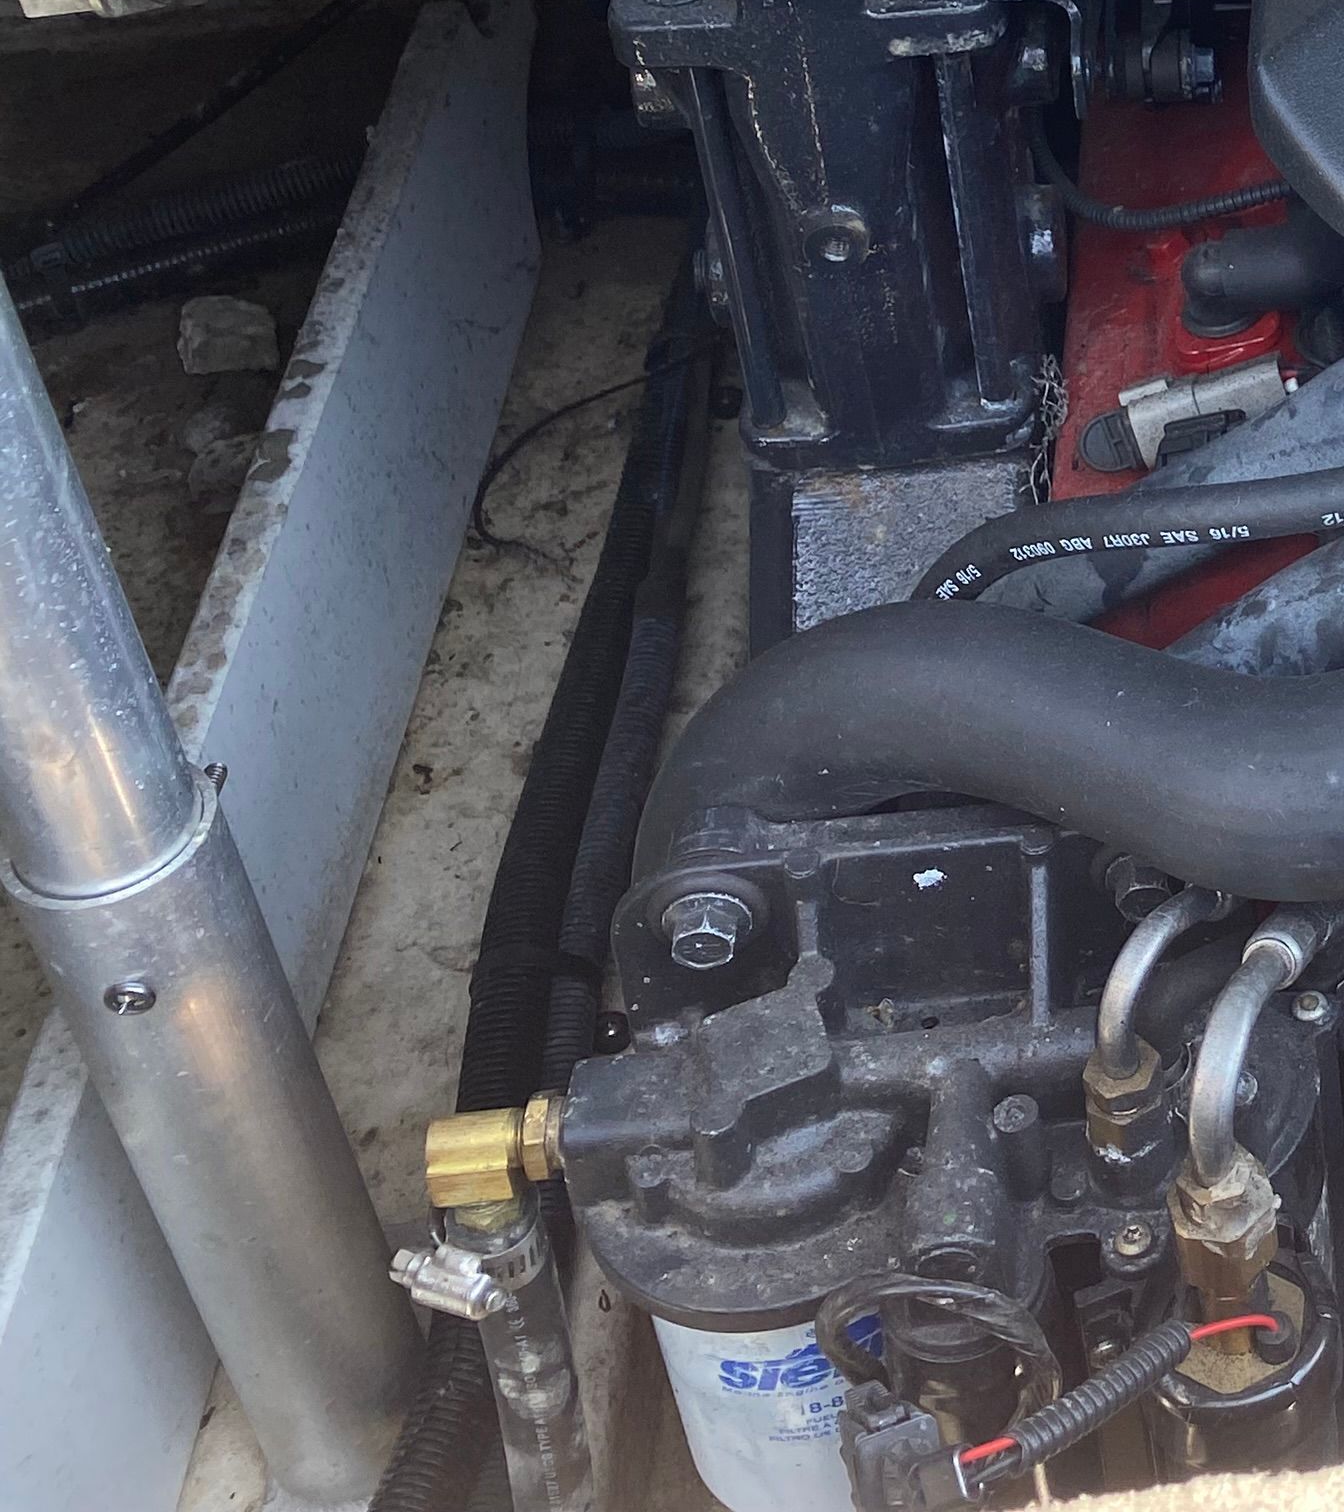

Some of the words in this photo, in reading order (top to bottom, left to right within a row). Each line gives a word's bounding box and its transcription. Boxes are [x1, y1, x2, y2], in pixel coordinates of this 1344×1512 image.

[1104, 533, 1150, 548] J30R7
[1160, 529, 1199, 544] SAE
[1209, 525, 1250, 540] 5/16
[1010, 541, 1056, 561] 090312
[1060, 536, 1093, 552] ABG
[956, 563, 982, 585] 5/16
[935, 578, 960, 601] SAE
[800, 1395, 844, 1416] 18-8
